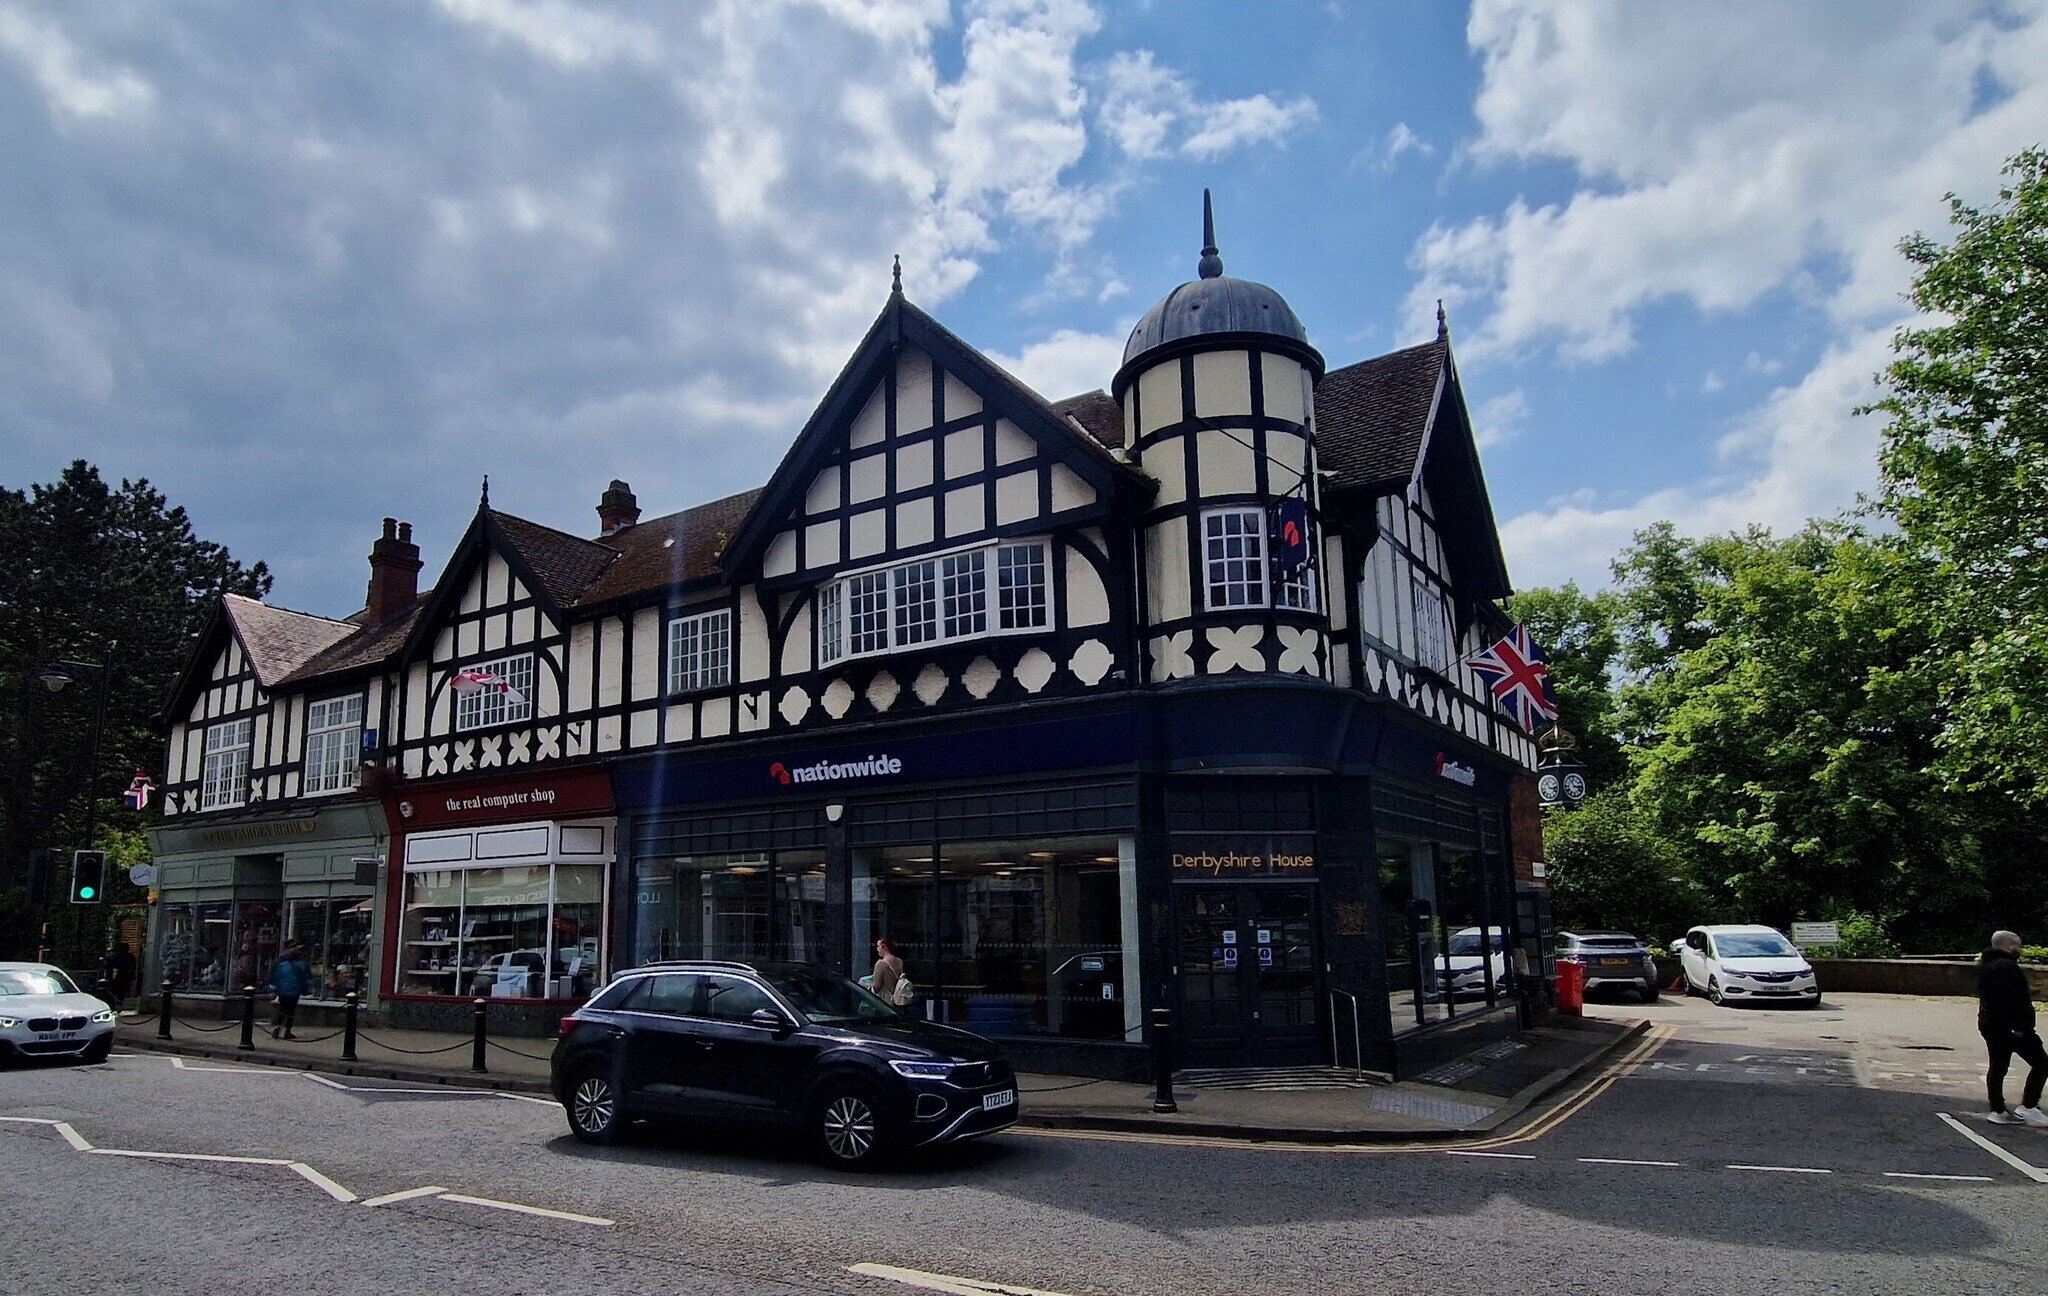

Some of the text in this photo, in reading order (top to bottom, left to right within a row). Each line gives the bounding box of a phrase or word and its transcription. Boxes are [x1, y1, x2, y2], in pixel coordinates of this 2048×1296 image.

[792, 754, 903, 783] nationwide
[446, 788, 555, 811] the real computer shop
[1172, 850, 1314, 876] Derbyshire House
